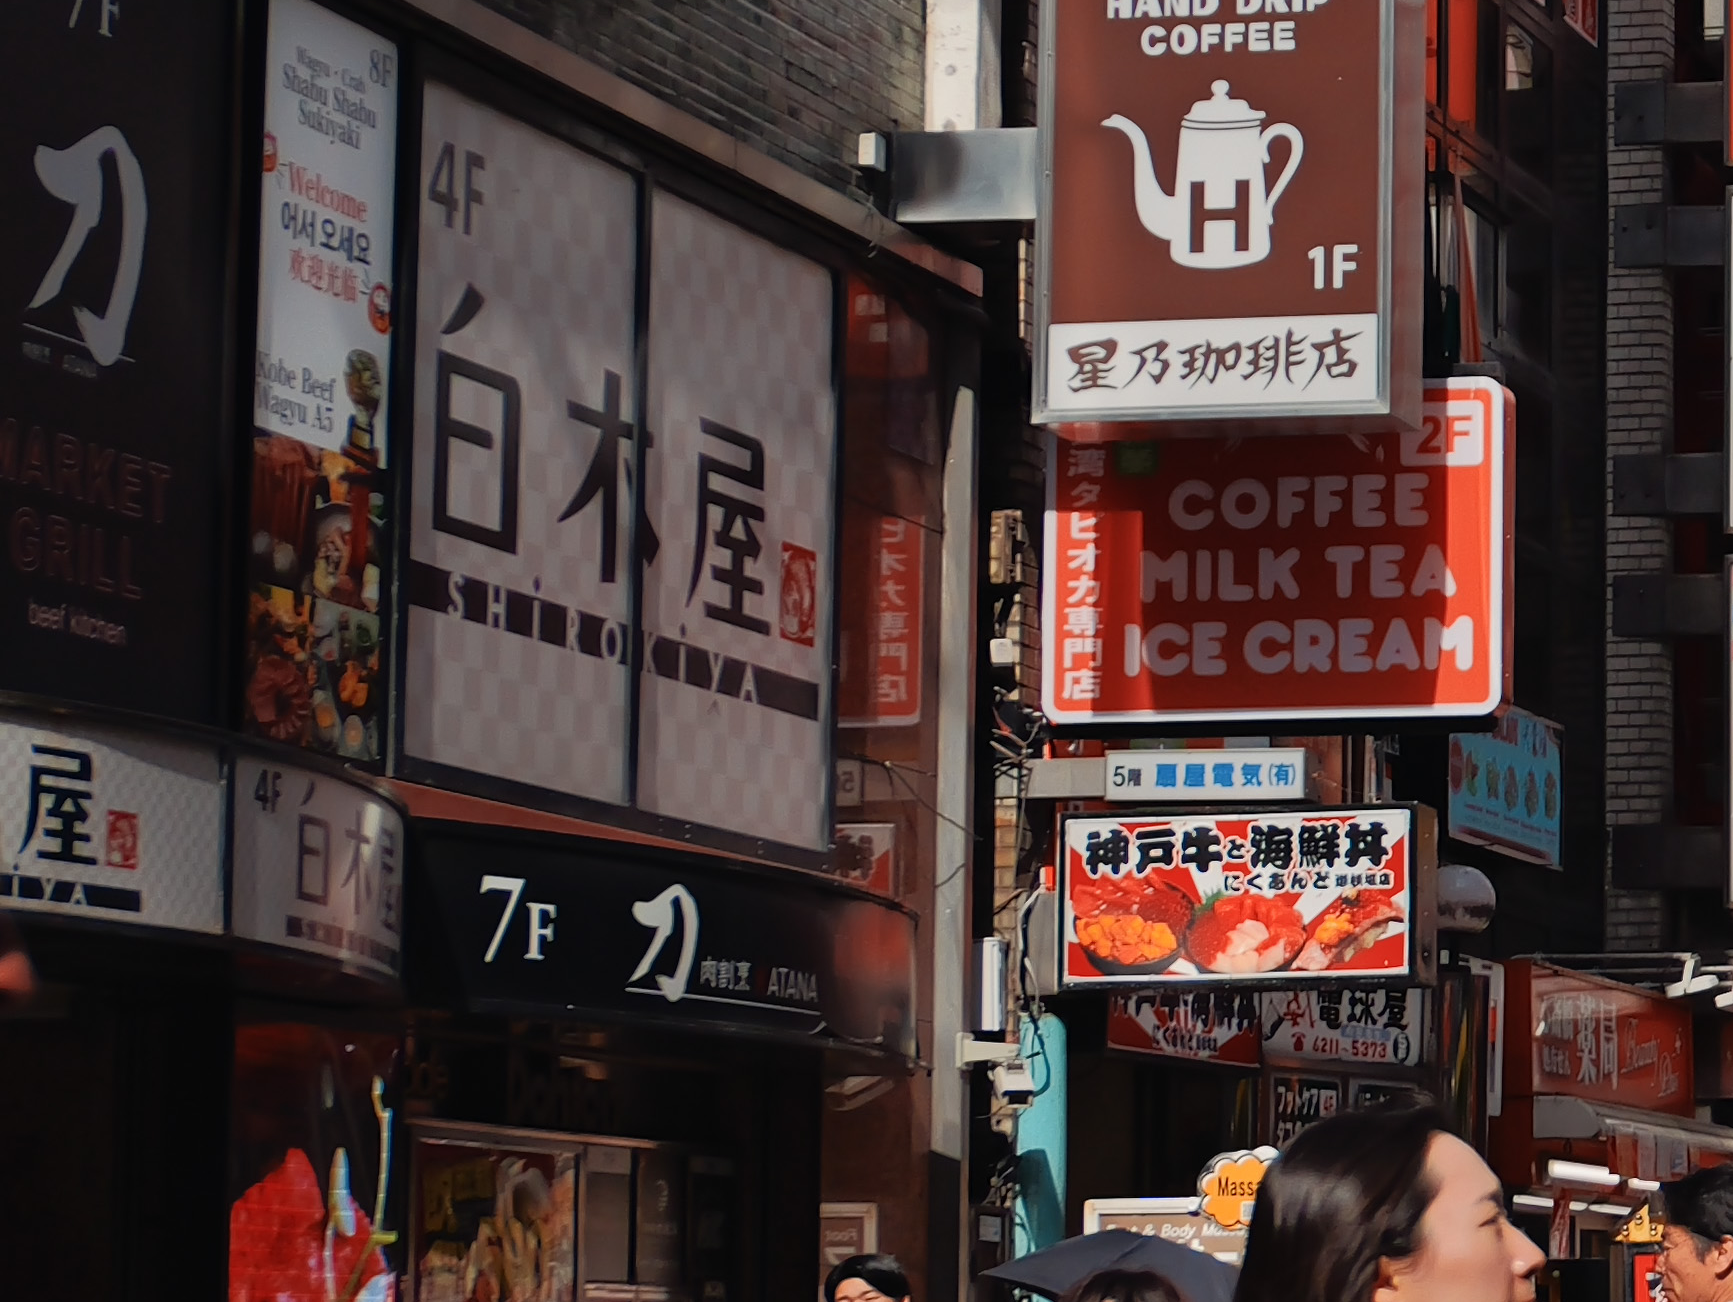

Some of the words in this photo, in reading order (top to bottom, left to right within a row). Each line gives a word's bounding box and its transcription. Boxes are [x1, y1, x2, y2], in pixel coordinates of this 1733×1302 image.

[1141, 21, 1296, 56] COFFEE
[286, 160, 368, 223] Welcome
[427, 139, 487, 236] 4F
[33, 124, 149, 367] 刀
[1307, 245, 1359, 289] 1F
[1066, 326, 1364, 393] 星乃珈琲店
[430, 280, 773, 637] 白木屋
[1415, 415, 1472, 456] 2F
[1168, 473, 1431, 531] COFFEE
[1140, 548, 1300, 603] MILK
[1325, 545, 1457, 599] TEA
[1123, 622, 1228, 677] ICE
[1243, 615, 1474, 676] CREAM
[19, 744, 98, 867] 屋
[1112, 765, 1142, 787] 5階
[1084, 821, 1392, 876] 神戸牛と海鮮丼
[479, 875, 558, 963] 7F
[627, 883, 699, 1003] 刀
